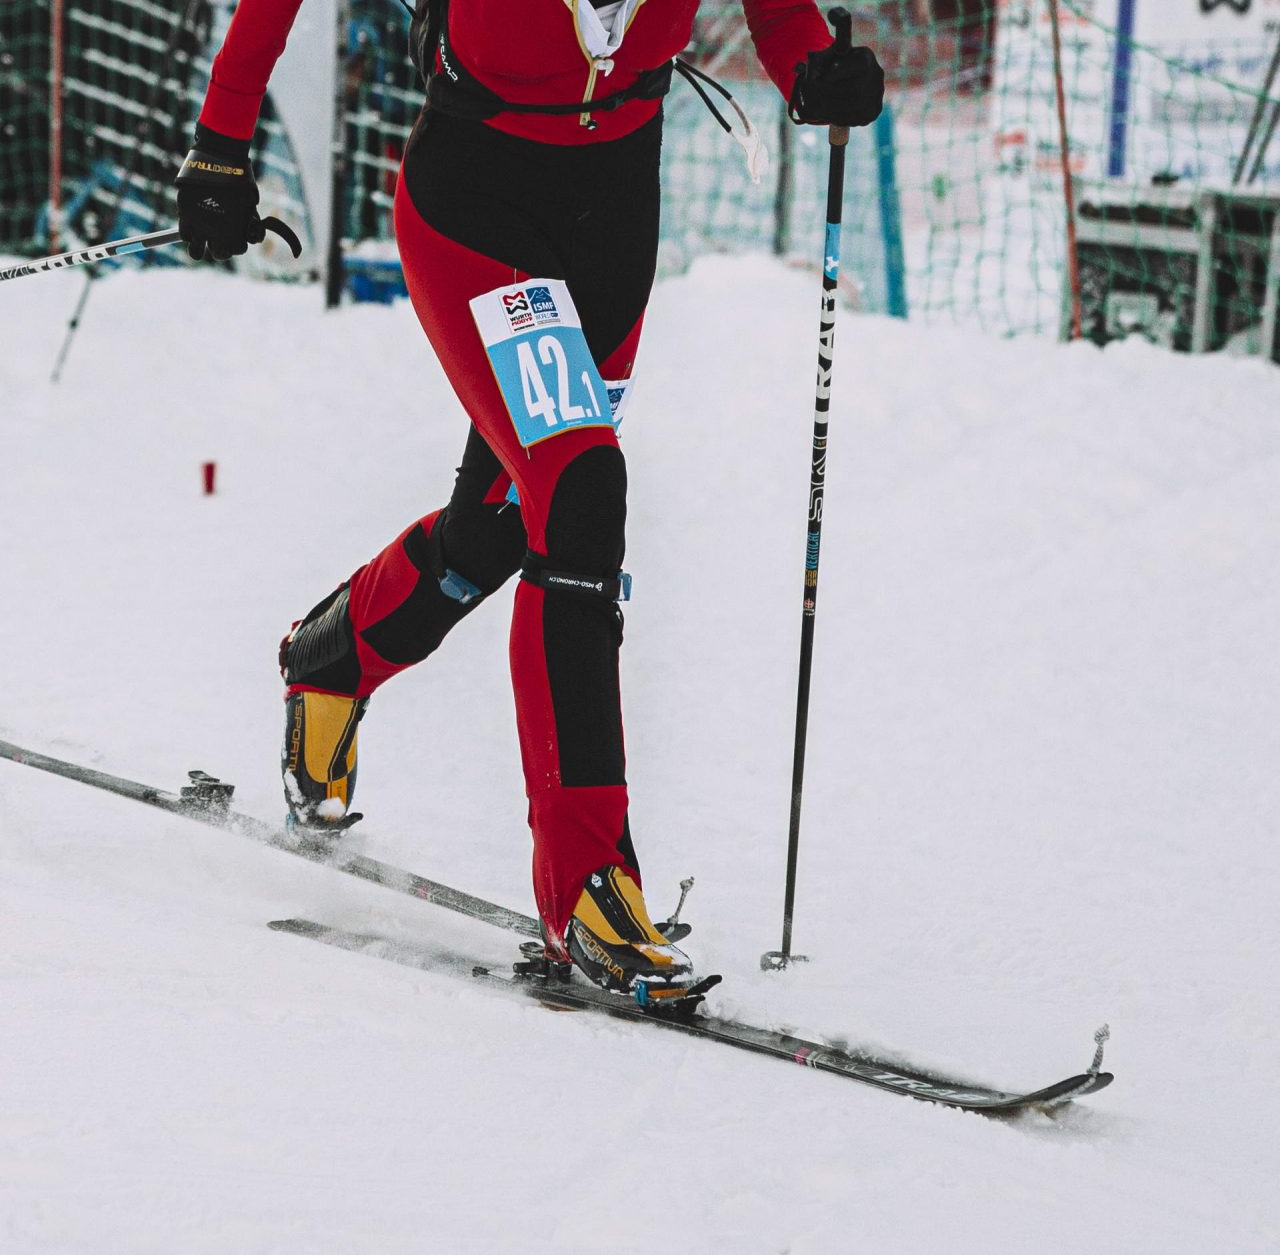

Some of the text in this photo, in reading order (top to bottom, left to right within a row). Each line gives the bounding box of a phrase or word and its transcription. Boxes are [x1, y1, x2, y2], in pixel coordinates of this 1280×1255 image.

[533, 301, 554, 312] ISMF
[517, 335, 601, 427] 42.1
[576, 925, 624, 983] SPORTIVA
